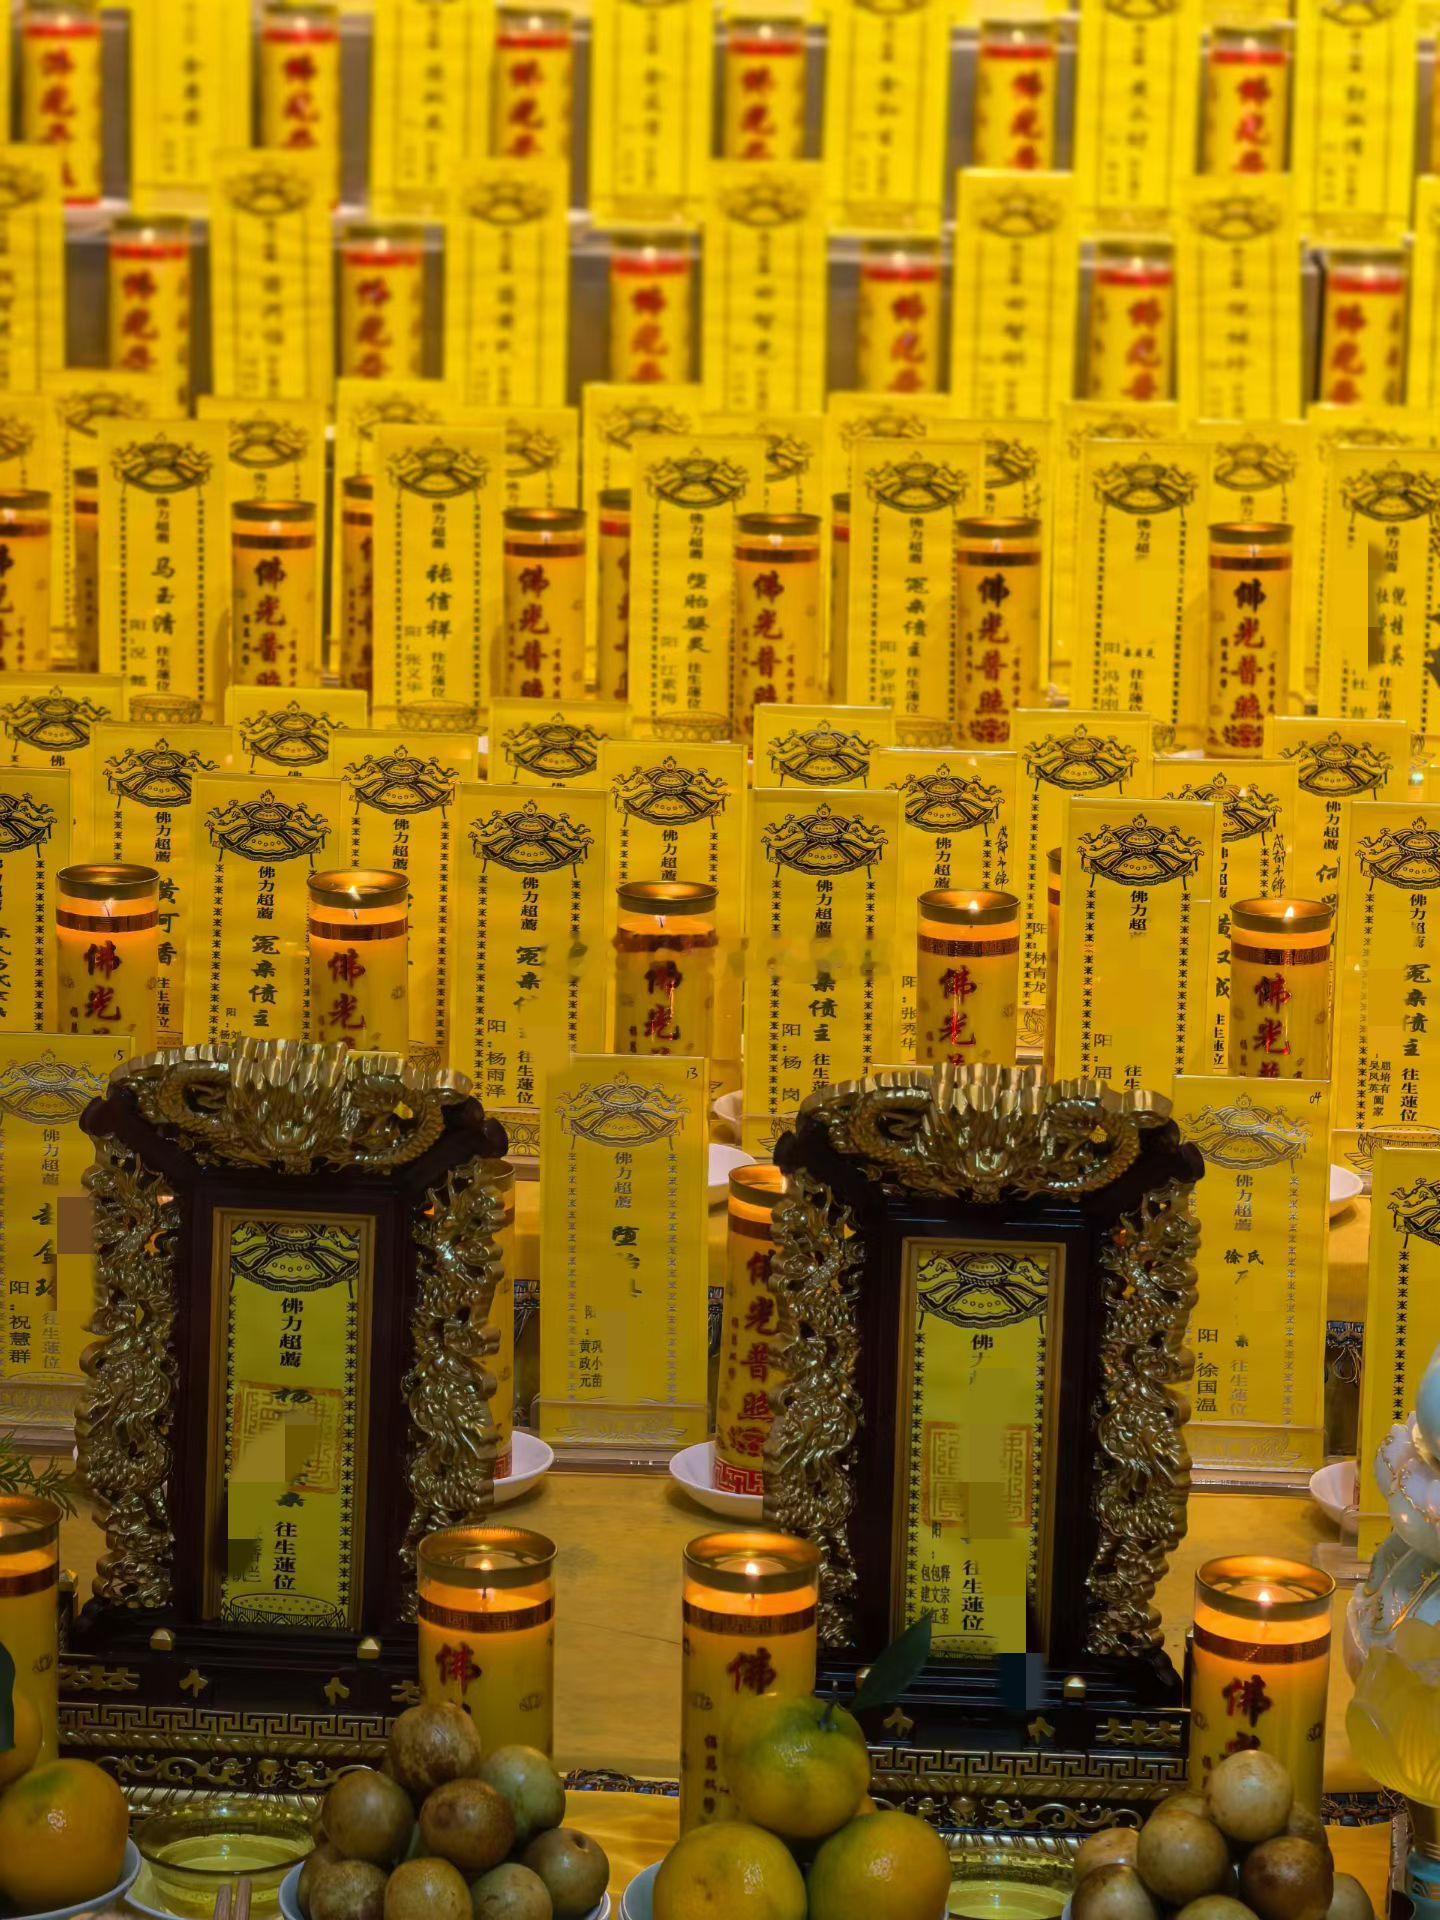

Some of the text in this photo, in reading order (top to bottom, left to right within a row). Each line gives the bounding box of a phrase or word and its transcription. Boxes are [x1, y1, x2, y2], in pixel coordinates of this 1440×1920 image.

[50, 754, 66, 768] 佛
[154, 810, 172, 864] 佛力超薦
[392, 818, 410, 871] 佛力超薦
[933, 836, 952, 889] 佛力超薦
[256, 864, 276, 920] 佛力超薦
[520, 876, 539, 932] 佛力超薦
[814, 879, 834, 937] 佛力超薦
[1128, 889, 1149, 938] 佛力超
[84, 939, 123, 1035] 佛光
[1399, 1066, 1420, 1122] 往生蓮位
[613, 1151, 634, 1210] 佛力超薦
[273, 1296, 304, 1591] 佛力超薦 往生蓮位
